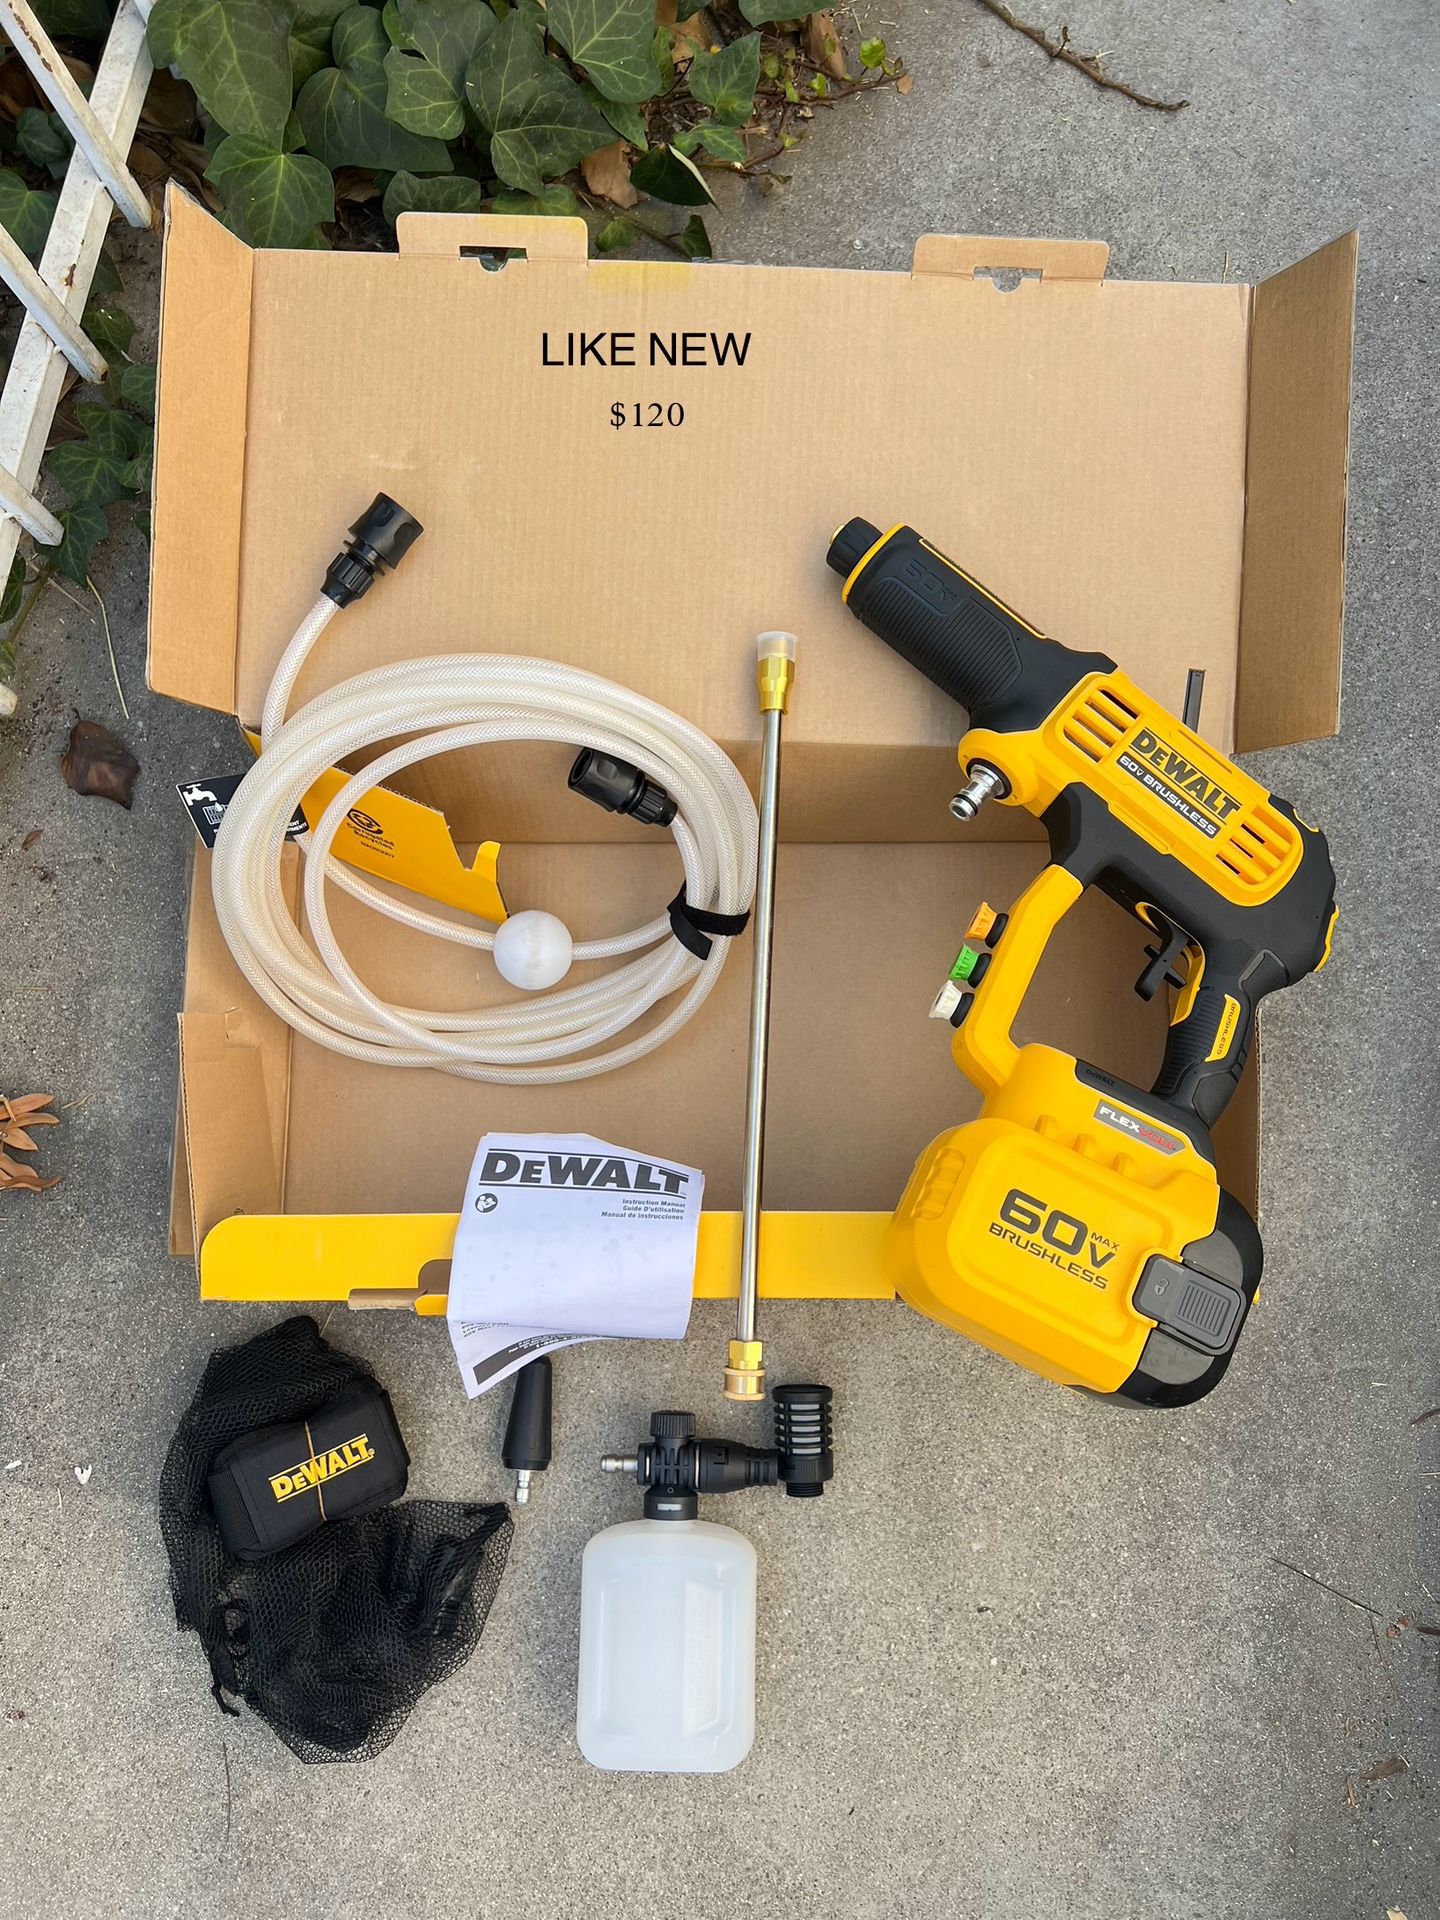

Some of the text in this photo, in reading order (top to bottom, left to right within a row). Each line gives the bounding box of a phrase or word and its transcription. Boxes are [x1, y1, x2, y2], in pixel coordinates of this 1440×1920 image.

[1143, 774, 1218, 836] BRUSHLESS
[1216, 1002, 1237, 1055] BRUSHLESS
[622, 1199, 658, 1207] Instruction
[623, 1205, 643, 1213] Guide
[601, 1211, 626, 1219] Manual
[1091, 1232, 1120, 1251] MAX
[989, 1222, 1109, 1291] BRUSHLESS
